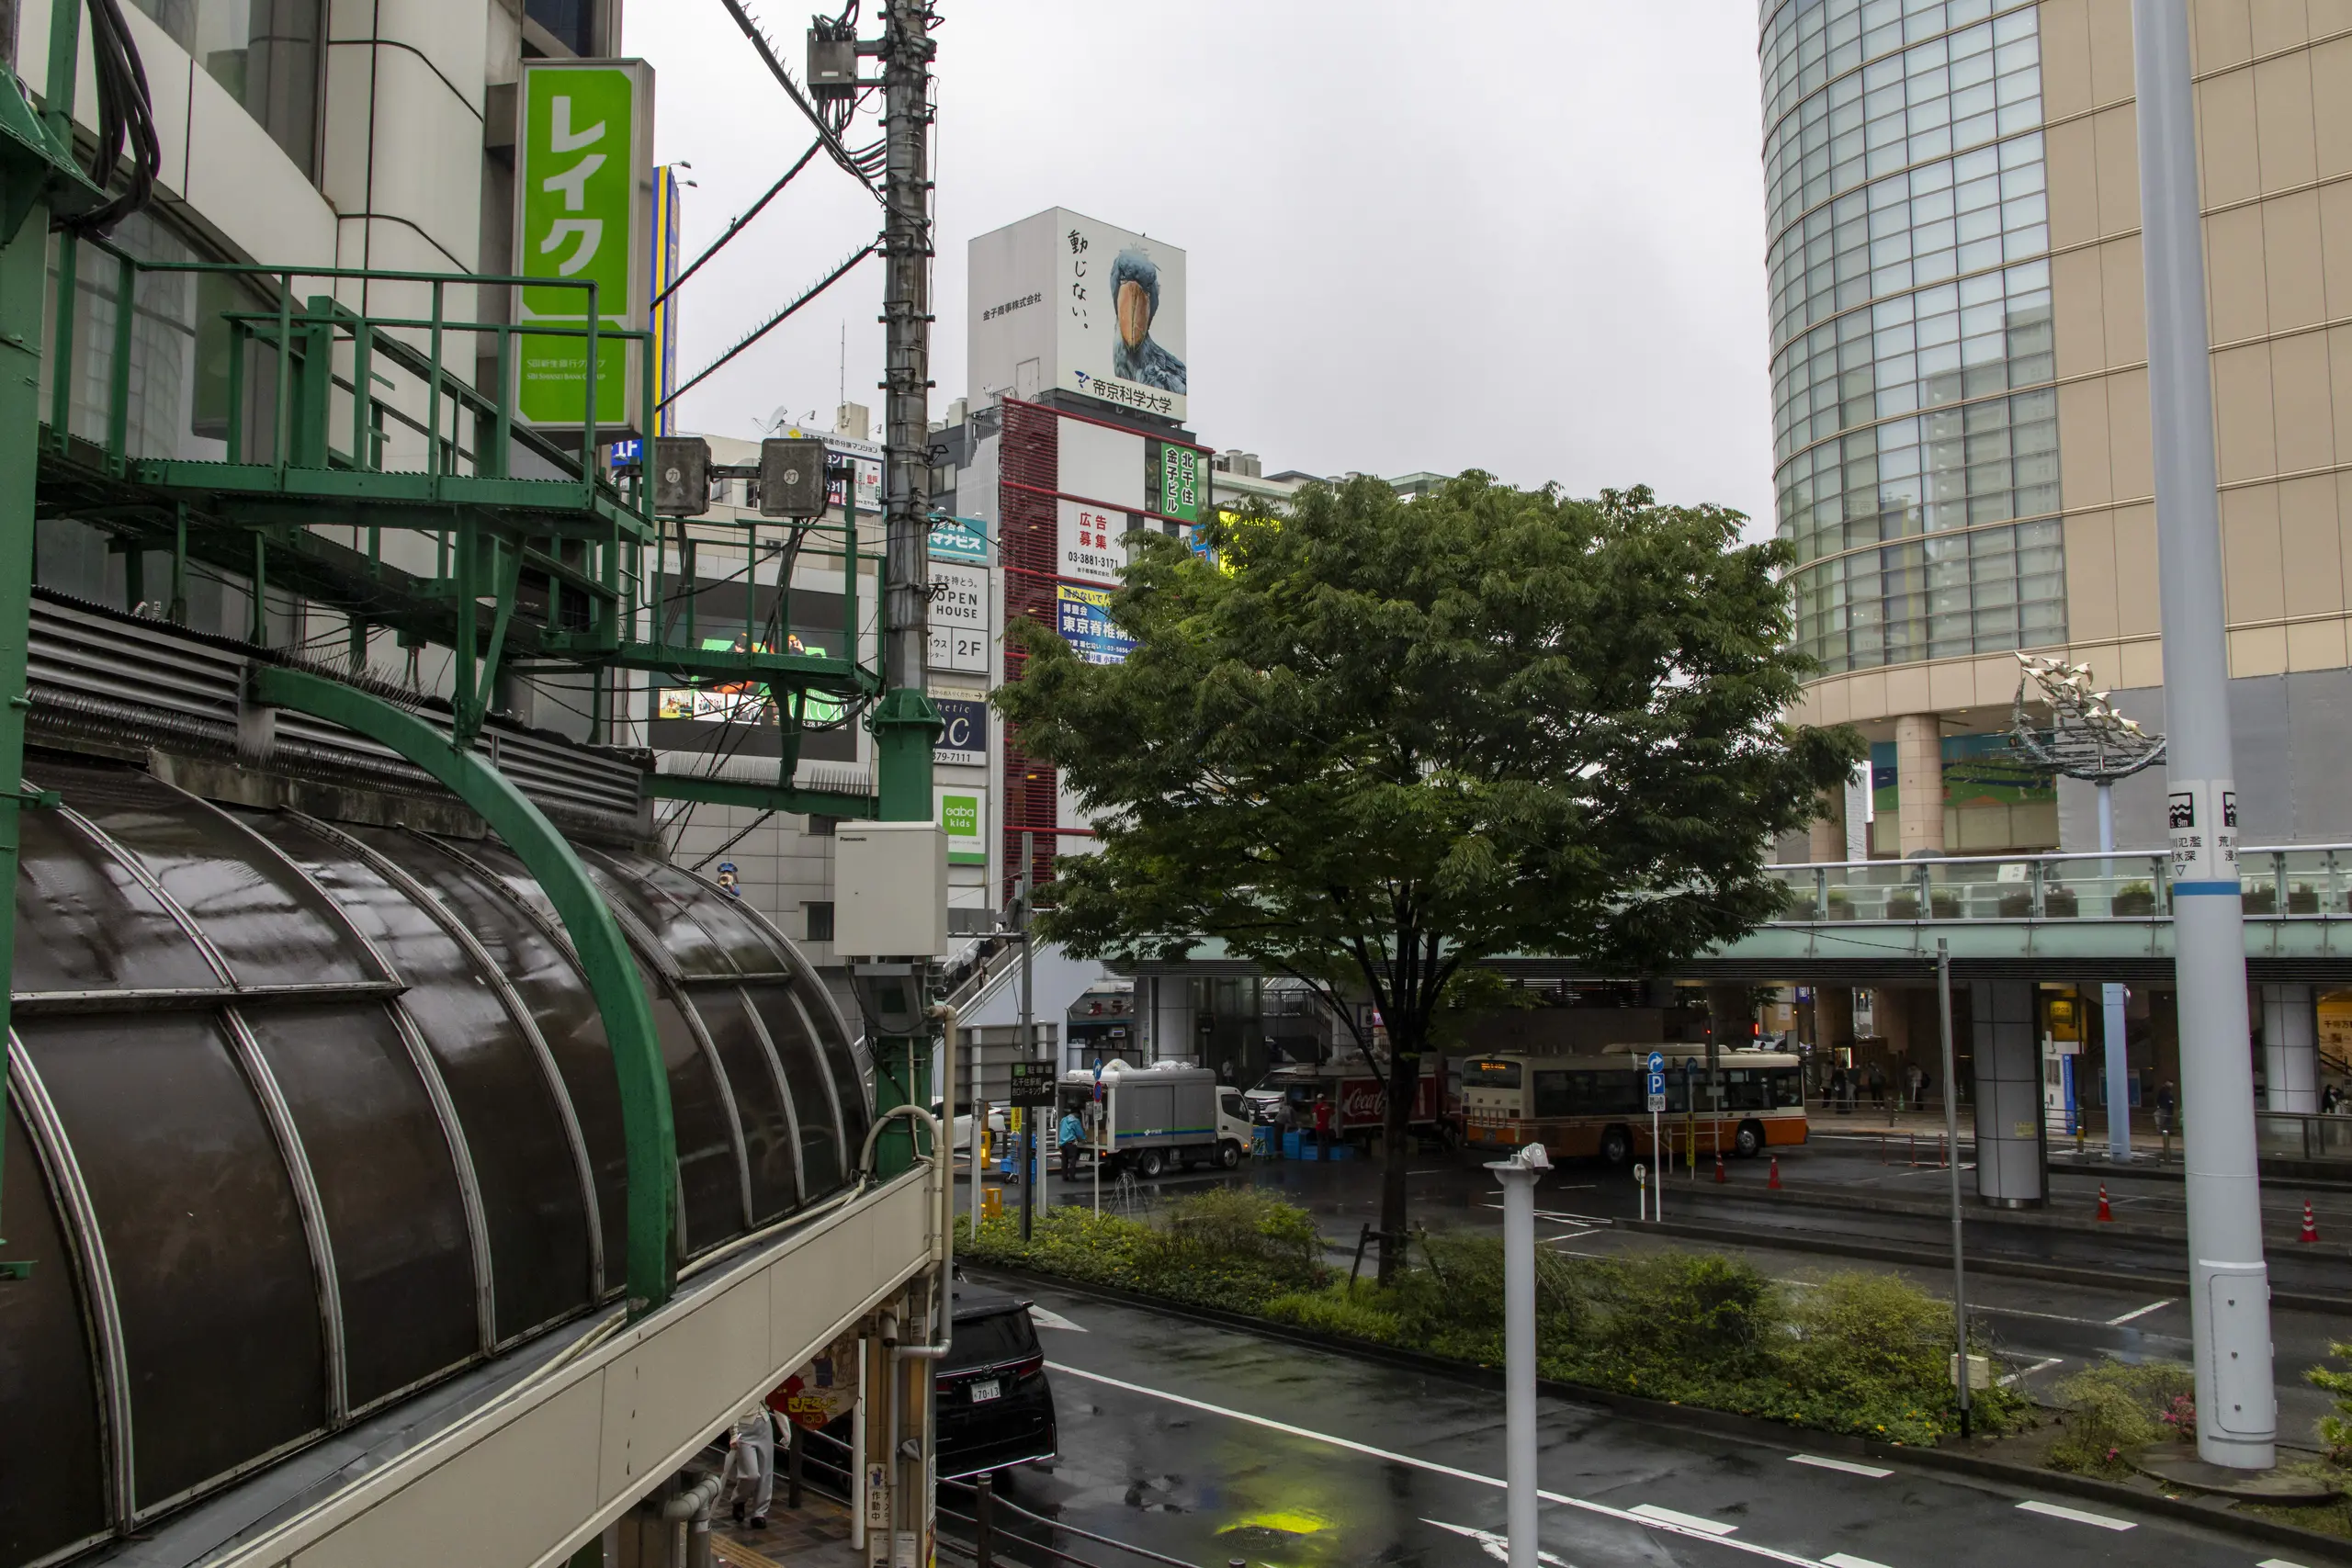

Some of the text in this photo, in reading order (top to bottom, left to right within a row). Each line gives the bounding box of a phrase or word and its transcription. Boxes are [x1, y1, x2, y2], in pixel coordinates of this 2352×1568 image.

[541, 96, 607, 276] レイク
[1068, 230, 1088, 329] 動じない。
[983, 292, 1041, 321] 金子商事株式会社
[526, 359, 606, 368] SBI新生銀行グプ
[1092, 378, 1172, 413] 帝京科学大学
[1166, 448, 1178, 513] 金子ビル
[1182, 452, 1194, 504] 北千住
[1080, 512, 1107, 531] 広告
[927, 533, 981, 550] マナビス
[1080, 531, 1107, 550] 募集
[1069, 551, 1118, 569] 03-3881-3171
[937, 590, 978, 605] OPEN
[936, 605, 978, 619] HOUSE
[957, 640, 981, 656] 2F
[949, 818, 971, 828] kids
[1652, 1076, 1662, 1093] P
[872, 1490, 881, 1521] 作動中
